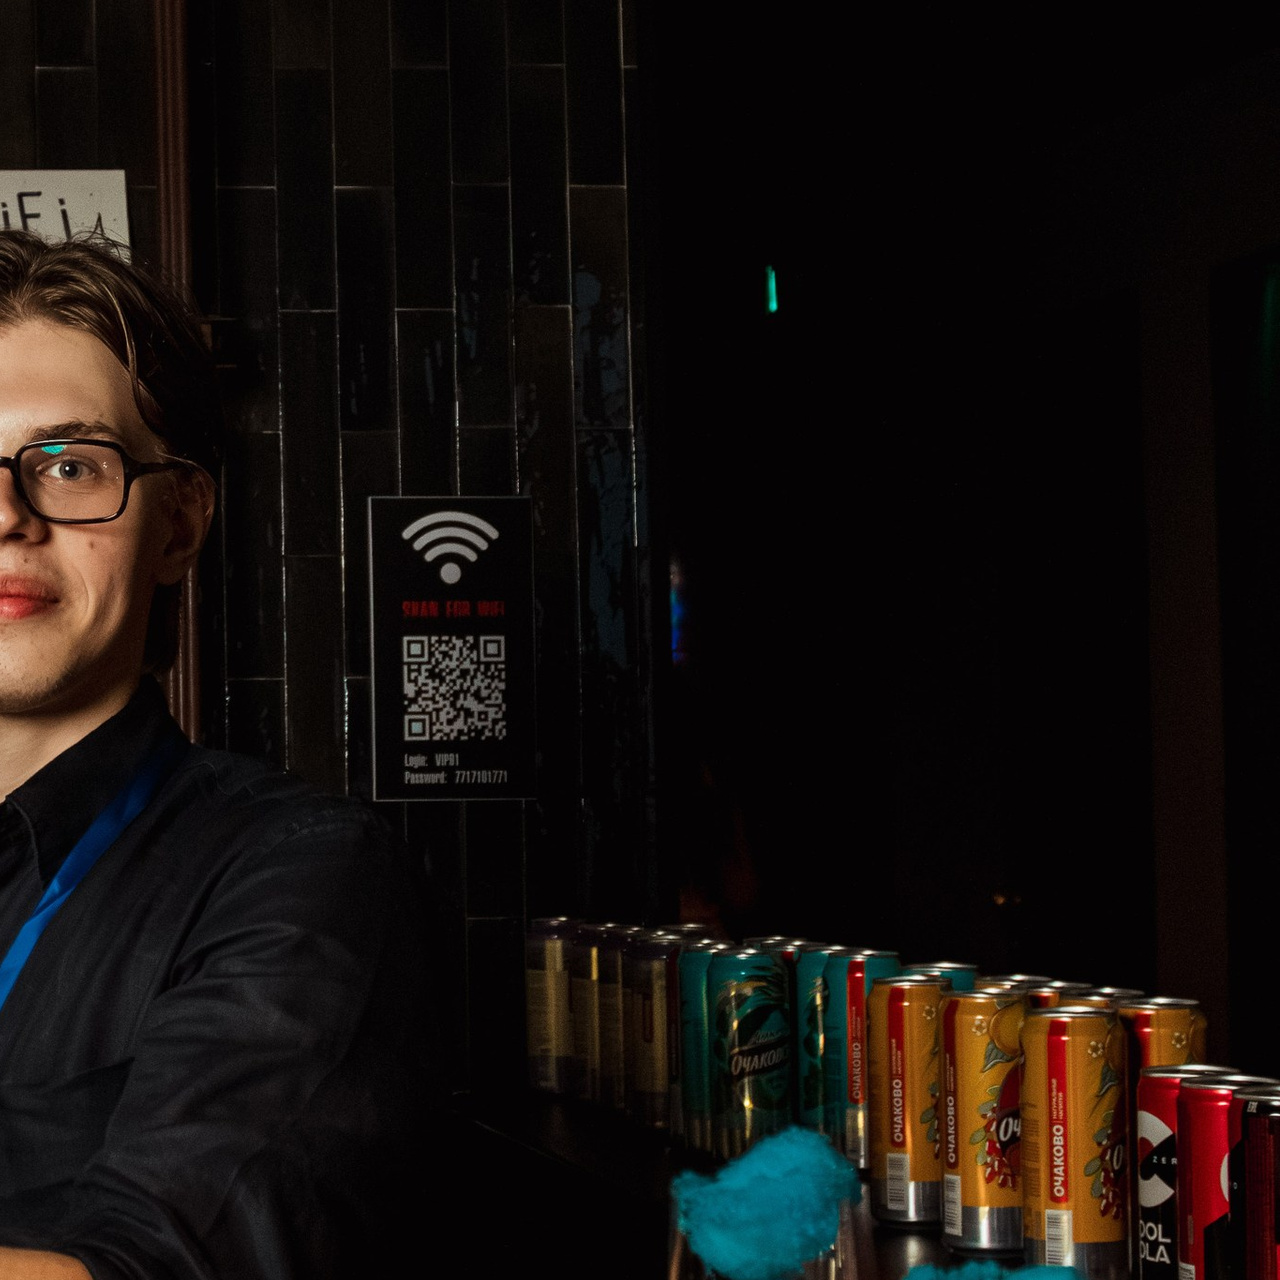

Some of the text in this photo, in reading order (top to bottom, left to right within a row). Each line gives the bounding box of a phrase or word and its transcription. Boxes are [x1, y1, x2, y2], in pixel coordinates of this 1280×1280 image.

[852, 1042, 862, 1099] ОЧАКОВО
[892, 1079, 903, 1142] ОЧАКОВО
[947, 1096, 956, 1163] ОЧАКОВО
[1053, 1124, 1065, 1197] ОЧАКОВО
[1152, 1155, 1178, 1165] ZER
